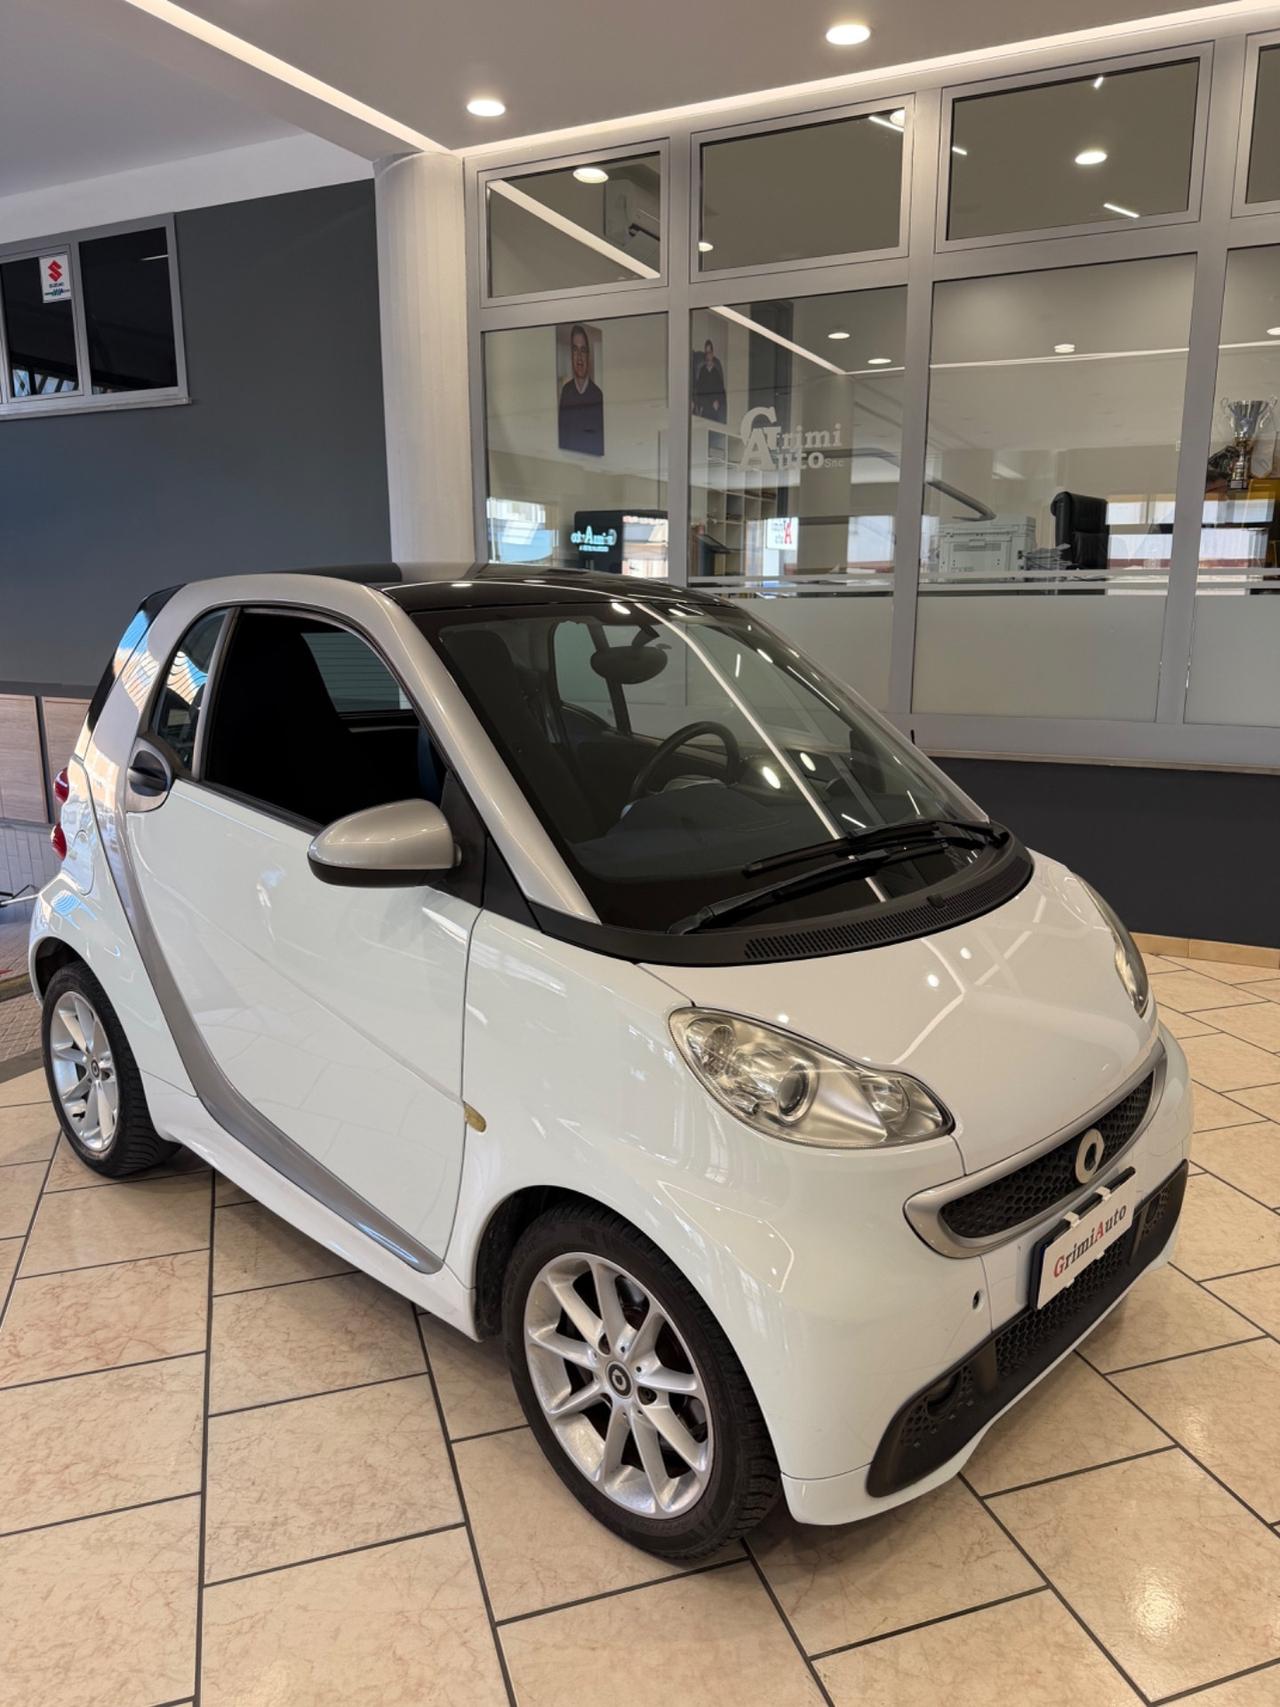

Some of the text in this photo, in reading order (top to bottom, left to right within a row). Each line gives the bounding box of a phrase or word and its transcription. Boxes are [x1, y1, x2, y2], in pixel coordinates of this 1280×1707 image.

[737, 427, 824, 472] Auto
[741, 406, 842, 449] Grimi
[1053, 1204, 1127, 1278] GrimiAuto
